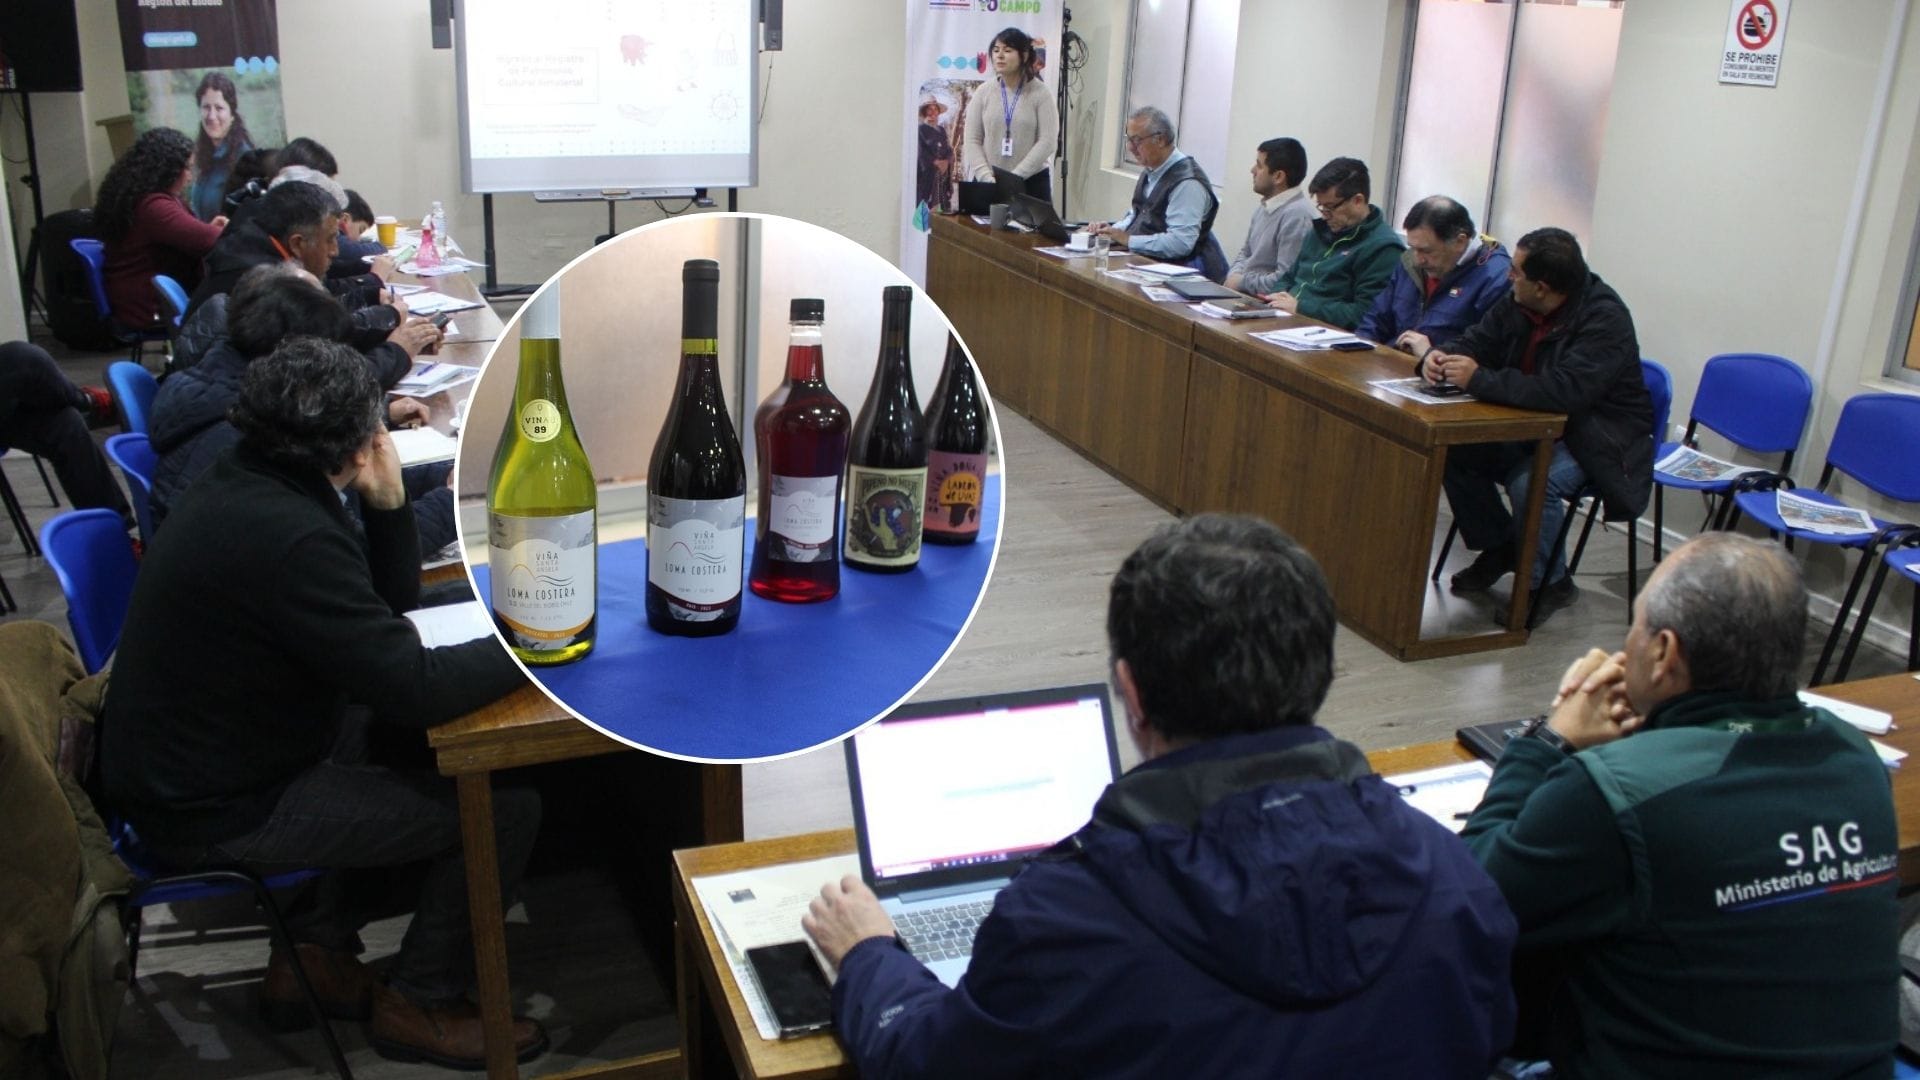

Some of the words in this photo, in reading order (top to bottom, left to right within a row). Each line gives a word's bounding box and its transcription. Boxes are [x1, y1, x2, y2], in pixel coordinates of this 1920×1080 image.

[1000, 0, 1041, 14] CAMPO
[1725, 52, 1737, 62] SE
[1738, 52, 1777, 65] PROHIBE
[534, 426, 547, 434] 89
[694, 530, 715, 540] VIÑA
[536, 551, 559, 560] VIÑA
[665, 562, 687, 574] LOMA
[692, 563, 727, 576] COSTERA
[507, 586, 529, 599] LOMA
[536, 587, 576, 600] COSTERA
[1779, 821, 1863, 867] SAG
[1715, 871, 1814, 907] Ministerio
[1818, 863, 1838, 883] de
